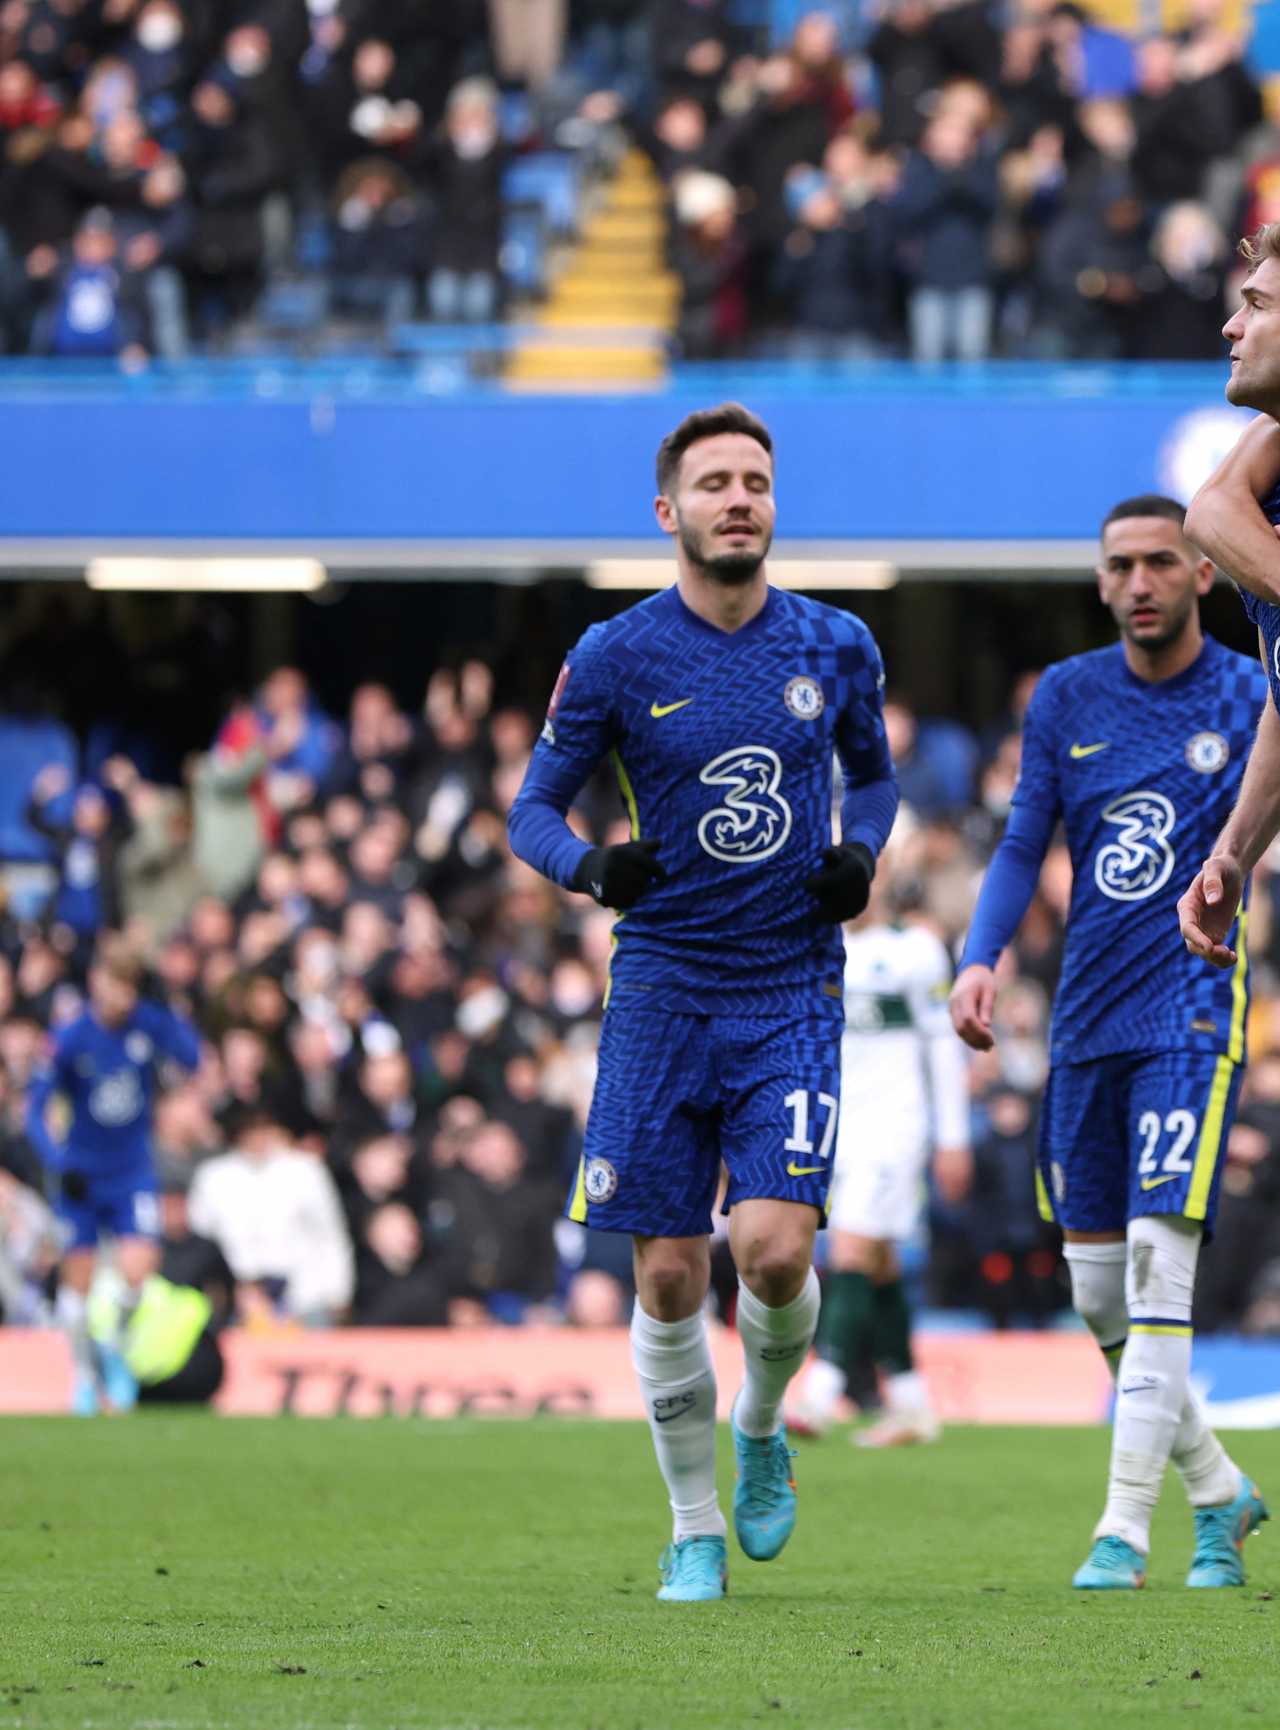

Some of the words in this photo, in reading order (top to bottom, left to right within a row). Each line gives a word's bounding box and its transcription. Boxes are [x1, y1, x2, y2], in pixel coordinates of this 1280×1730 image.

[698, 745, 792, 863] 3
[1094, 791, 1176, 901] 3
[784, 1089, 838, 1159] 17
[1138, 1110, 1196, 1174] 22
